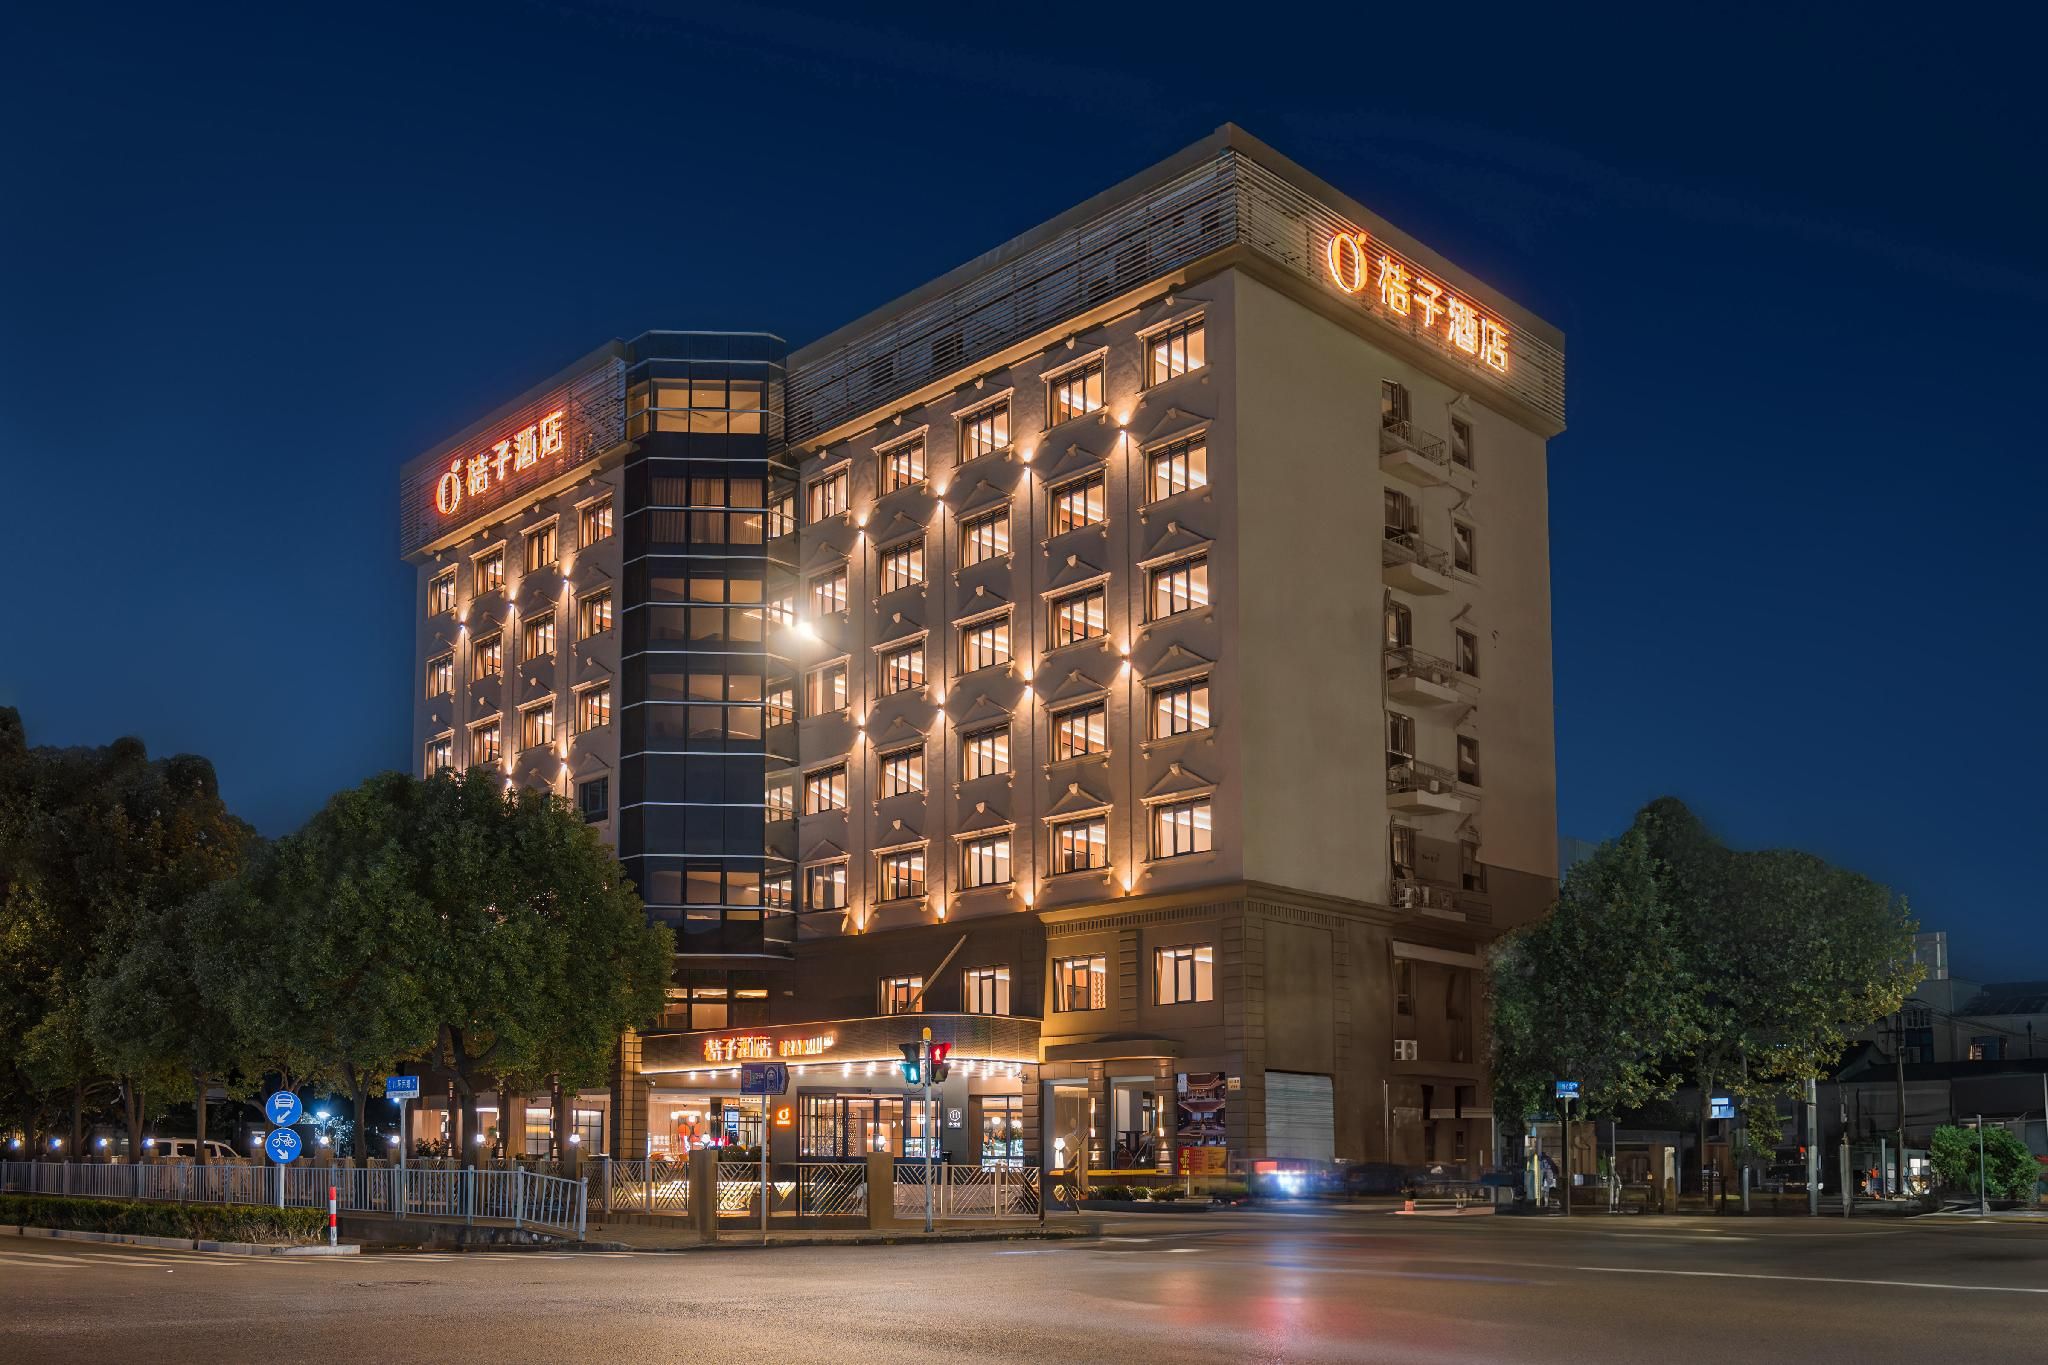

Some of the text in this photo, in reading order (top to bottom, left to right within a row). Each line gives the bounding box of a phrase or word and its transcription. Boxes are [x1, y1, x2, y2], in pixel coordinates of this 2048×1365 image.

[1378, 255, 1509, 372] 桔子酒店
[466, 411, 563, 496] 桔子酒店
[703, 1036, 771, 1061] 桔子酒店
